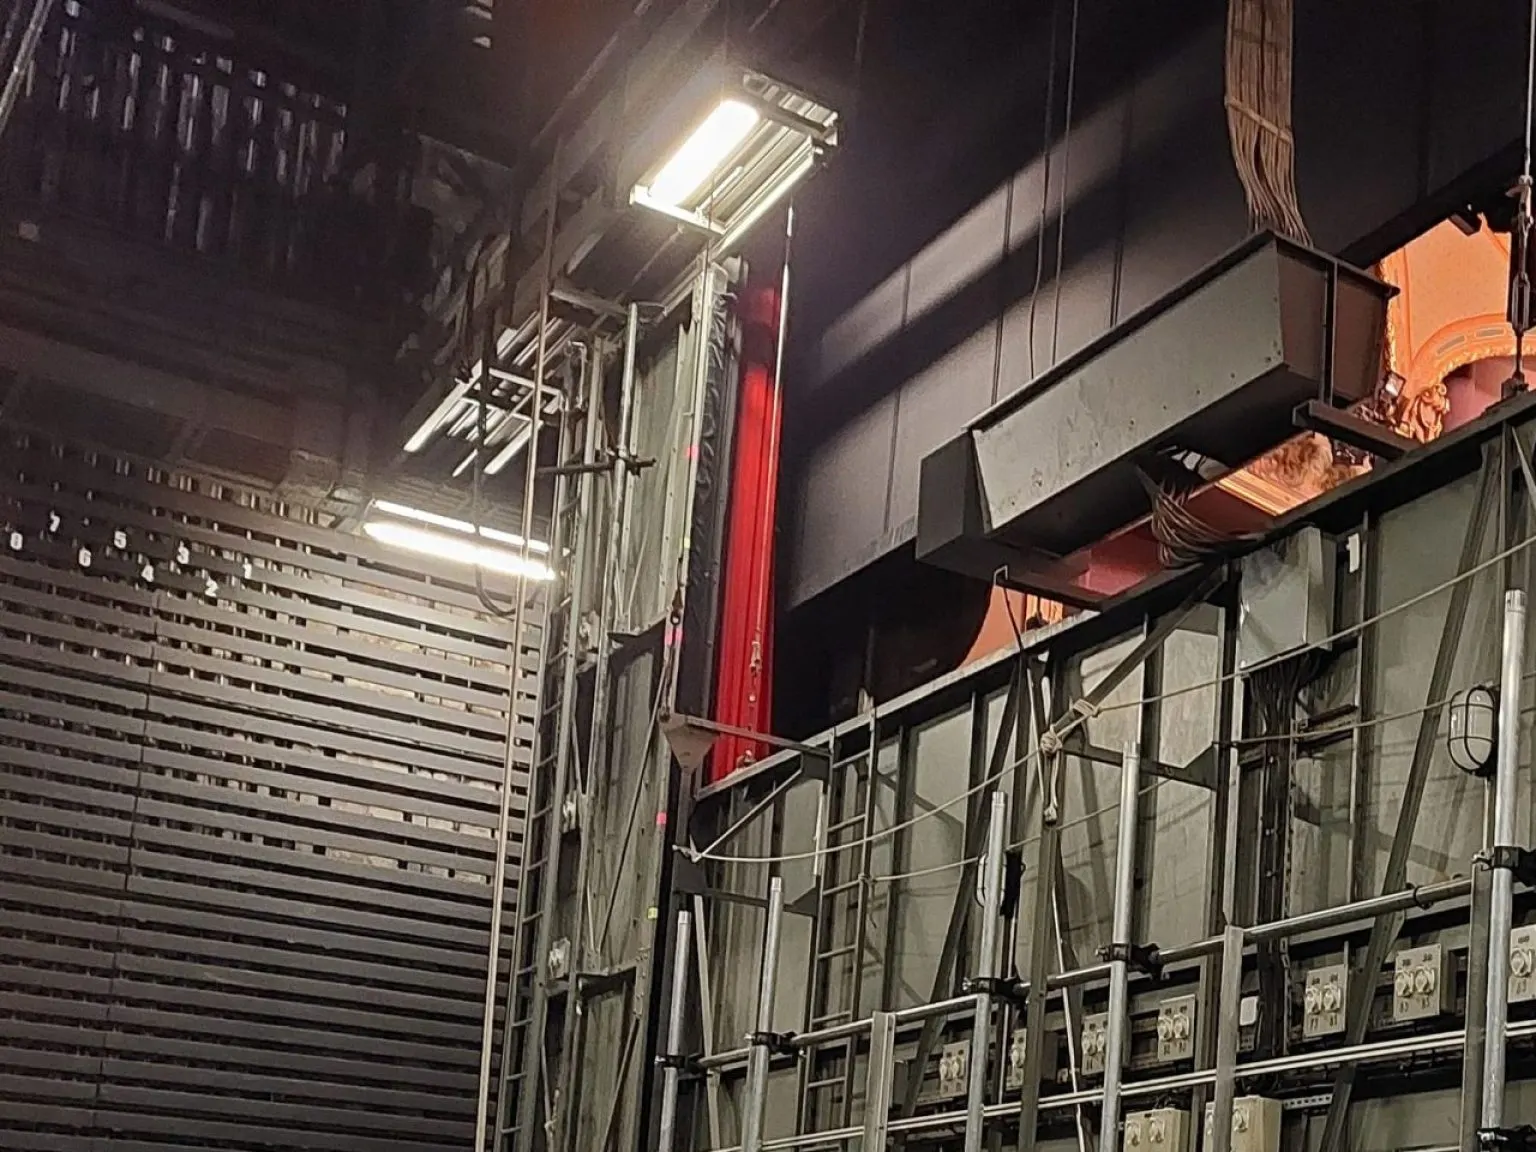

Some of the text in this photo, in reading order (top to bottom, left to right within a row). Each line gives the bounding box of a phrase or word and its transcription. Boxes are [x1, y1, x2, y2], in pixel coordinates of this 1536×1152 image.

[48, 509, 61, 533] 7
[9, 530, 23, 551] 8
[113, 529, 127, 550] 5
[78, 546, 92, 568] 6
[176, 540, 190, 565] 3
[141, 559, 155, 583] 4
[242, 557, 253, 580] 1
[204, 576, 219, 598] 2
